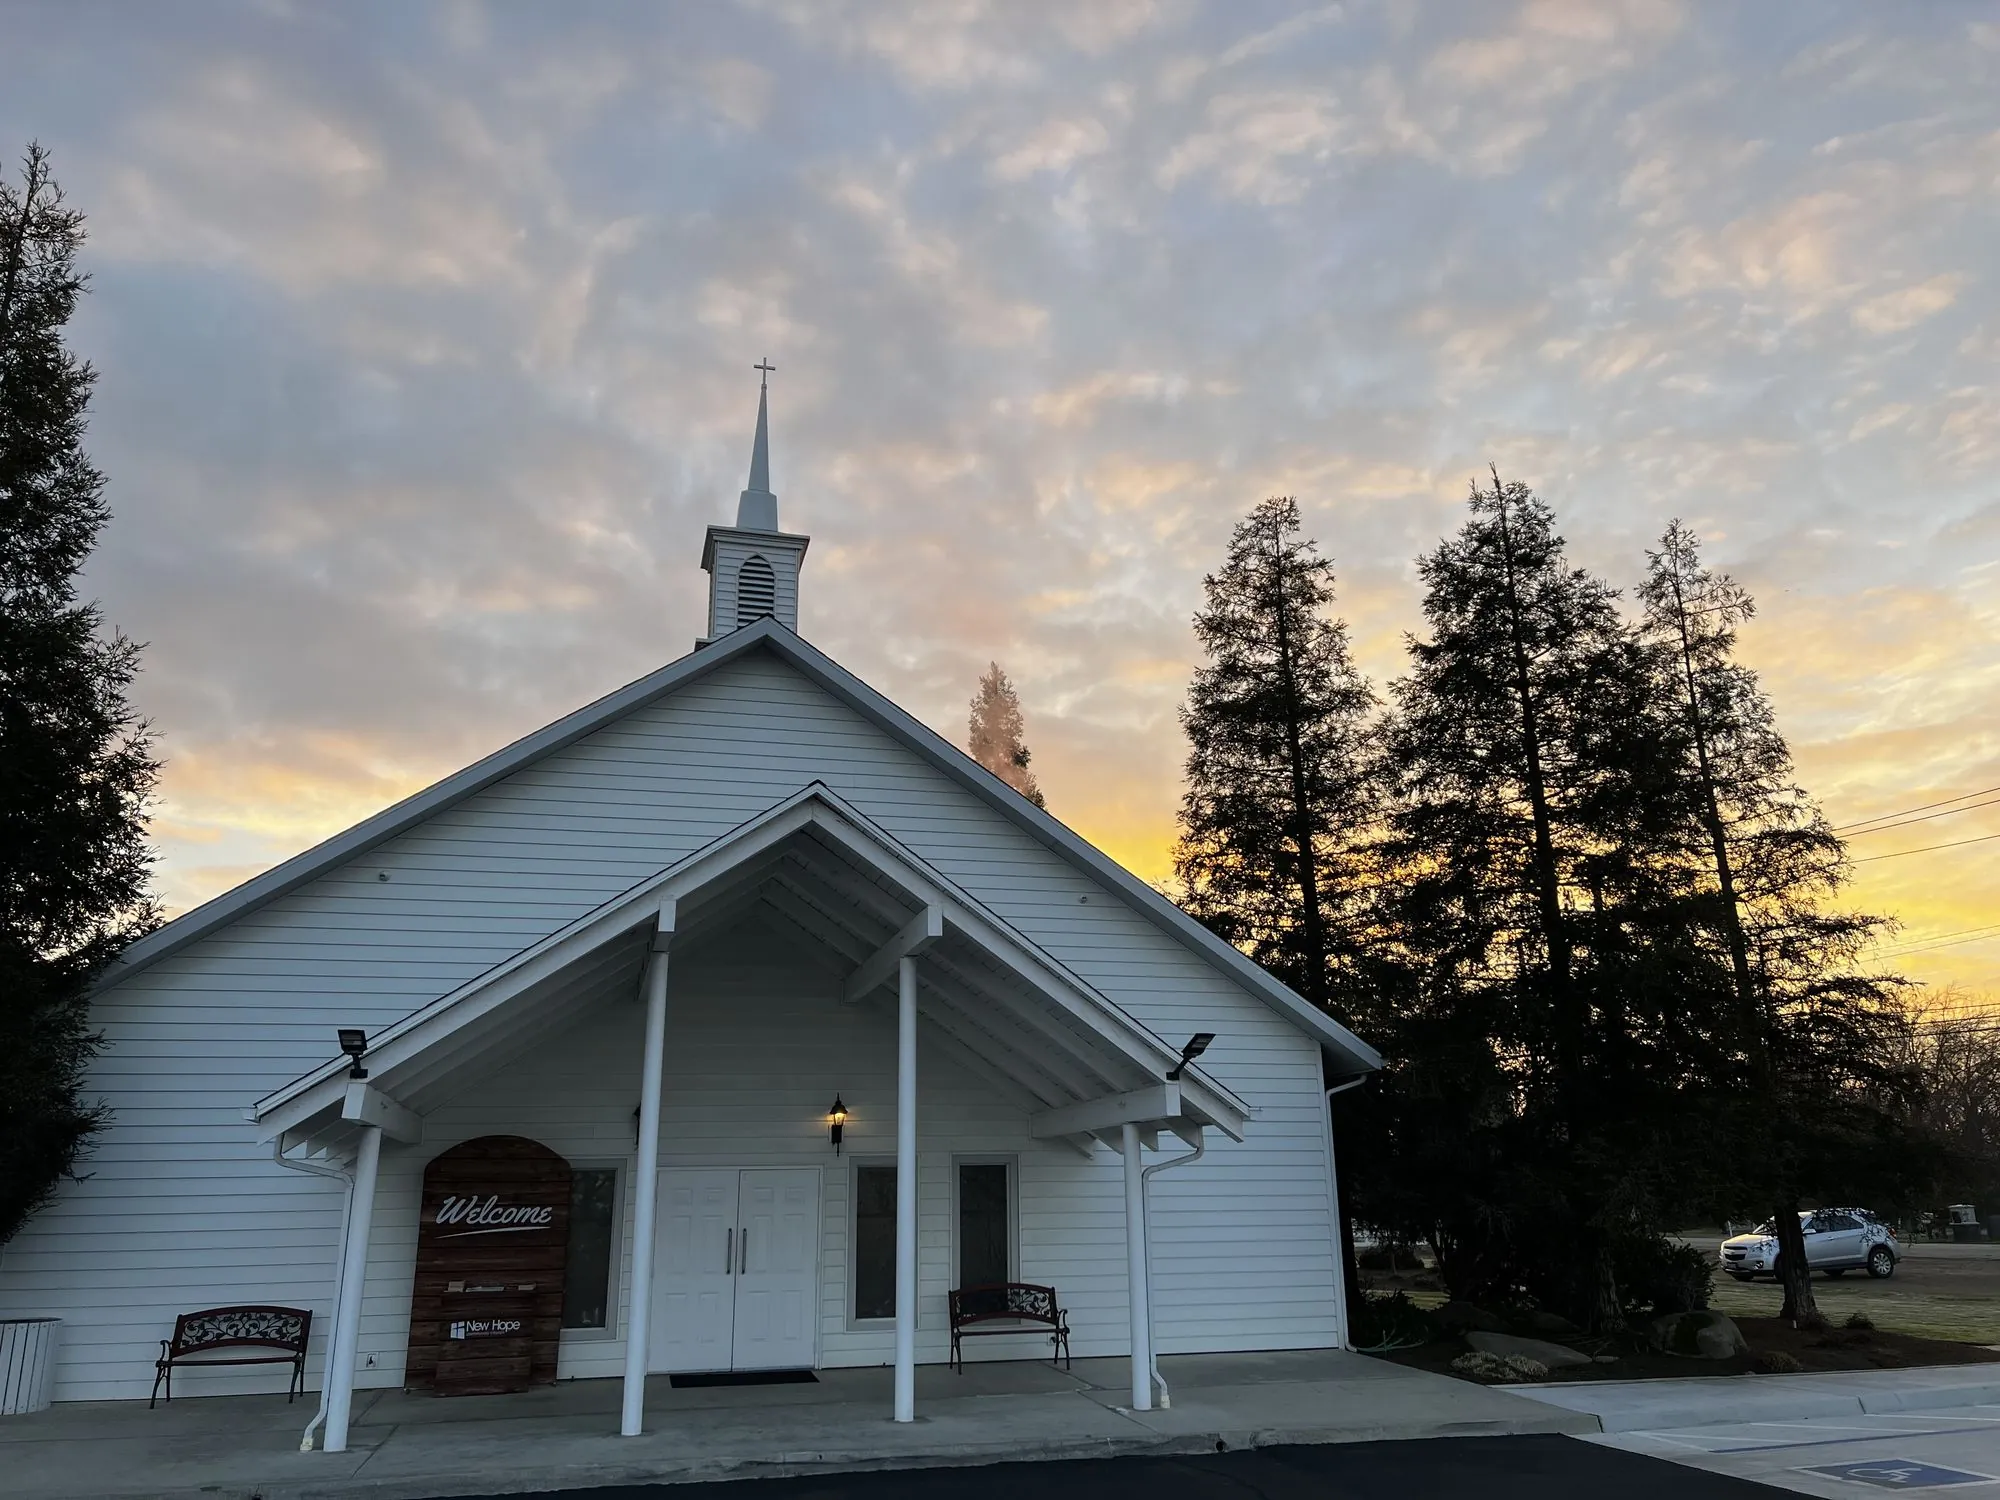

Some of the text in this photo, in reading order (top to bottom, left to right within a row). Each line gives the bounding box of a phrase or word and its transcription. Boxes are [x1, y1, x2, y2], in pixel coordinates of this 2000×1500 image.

[435, 1194, 553, 1225] Welcome
[466, 1319, 521, 1333] New Hope
